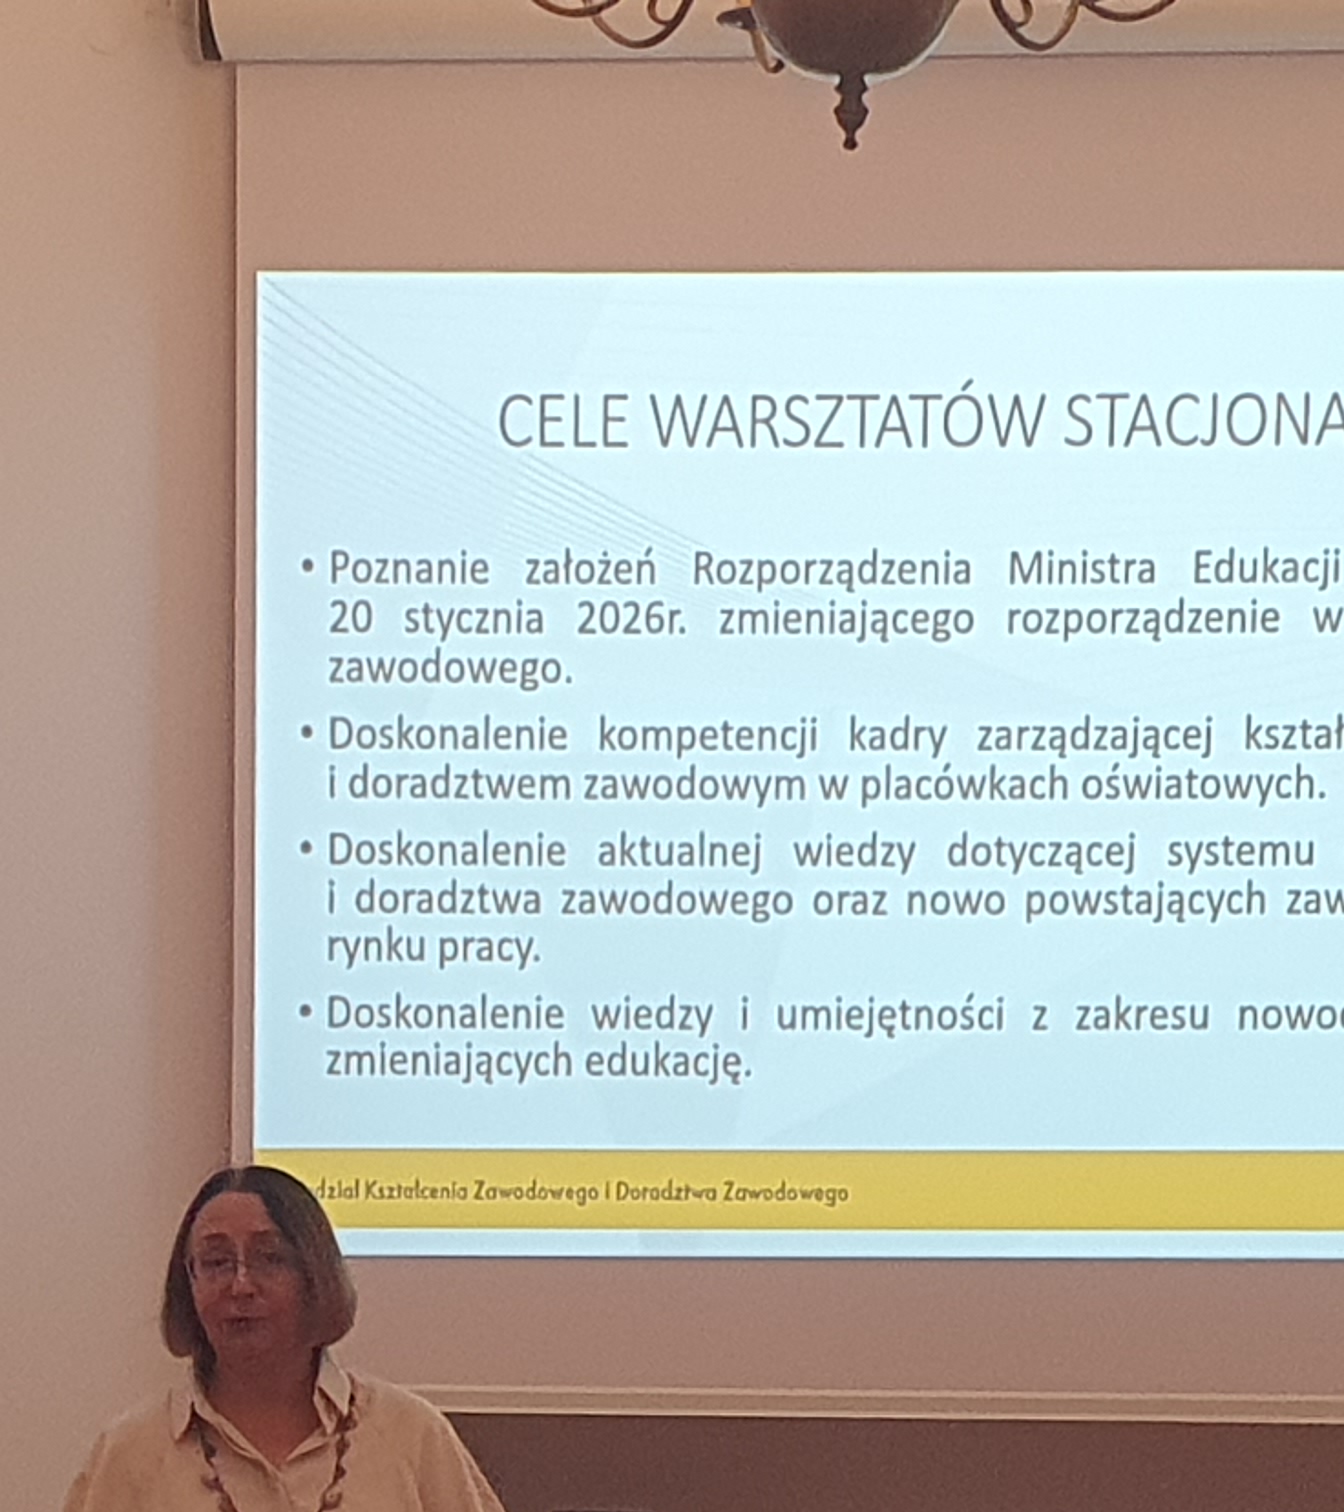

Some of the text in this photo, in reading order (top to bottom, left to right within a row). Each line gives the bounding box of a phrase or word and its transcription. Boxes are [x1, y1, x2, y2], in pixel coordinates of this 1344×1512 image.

[499, 393, 629, 448] CELE
[649, 378, 1047, 449] WARSZTATÓW
[330, 549, 490, 585] Poznanie
[525, 546, 656, 586] założeń
[693, 547, 971, 594] Rozporządzenia
[1009, 549, 1156, 585] Ministra
[1193, 546, 1341, 592] Edukacji
[329, 598, 373, 634] 20
[404, 598, 544, 643] stycznia
[577, 600, 686, 635] 2026r.
[719, 599, 975, 644] zmieniającego
[1007, 596, 1281, 643] rozporządzenie
[1312, 606, 1344, 633] w
[328, 645, 573, 692] zawodowego.
[329, 713, 568, 751] Doskonalenie
[599, 714, 818, 760] kompetencji
[849, 714, 948, 760] kadry
[977, 714, 1213, 760] zarządzającej
[328, 761, 1326, 809] i doradztwem zawodowym w placówkach oświatowych.
[329, 828, 566, 867] Doskonalenie
[598, 830, 762, 877] aktualnej
[793, 830, 917, 876] wiedzy
[947, 830, 1136, 876] dotyczącej
[1167, 831, 1315, 877] systemu
[327, 878, 336, 915] i
[354, 877, 541, 915] doradztwa
[561, 878, 794, 924] zawodowego
[812, 890, 888, 916] oraz
[907, 889, 1006, 916] nowo
[1025, 878, 1266, 924] powstających
[327, 924, 541, 971] rynku pracy.
[327, 991, 565, 1030] Doskonalenie
[591, 993, 714, 1038] wiedzy
[741, 995, 749, 1031] i
[777, 992, 1004, 1039] umiejętności
[1032, 1004, 1048, 1031] z
[1075, 994, 1210, 1031] zakresu
[326, 1040, 752, 1086] zmieniających edukację.
[315, 1175, 360, 1201] dział
[472, 1177, 600, 1208] Zawodowego
[615, 1177, 718, 1202] Doradztwa
[722, 1179, 849, 1208] Zawodowego
